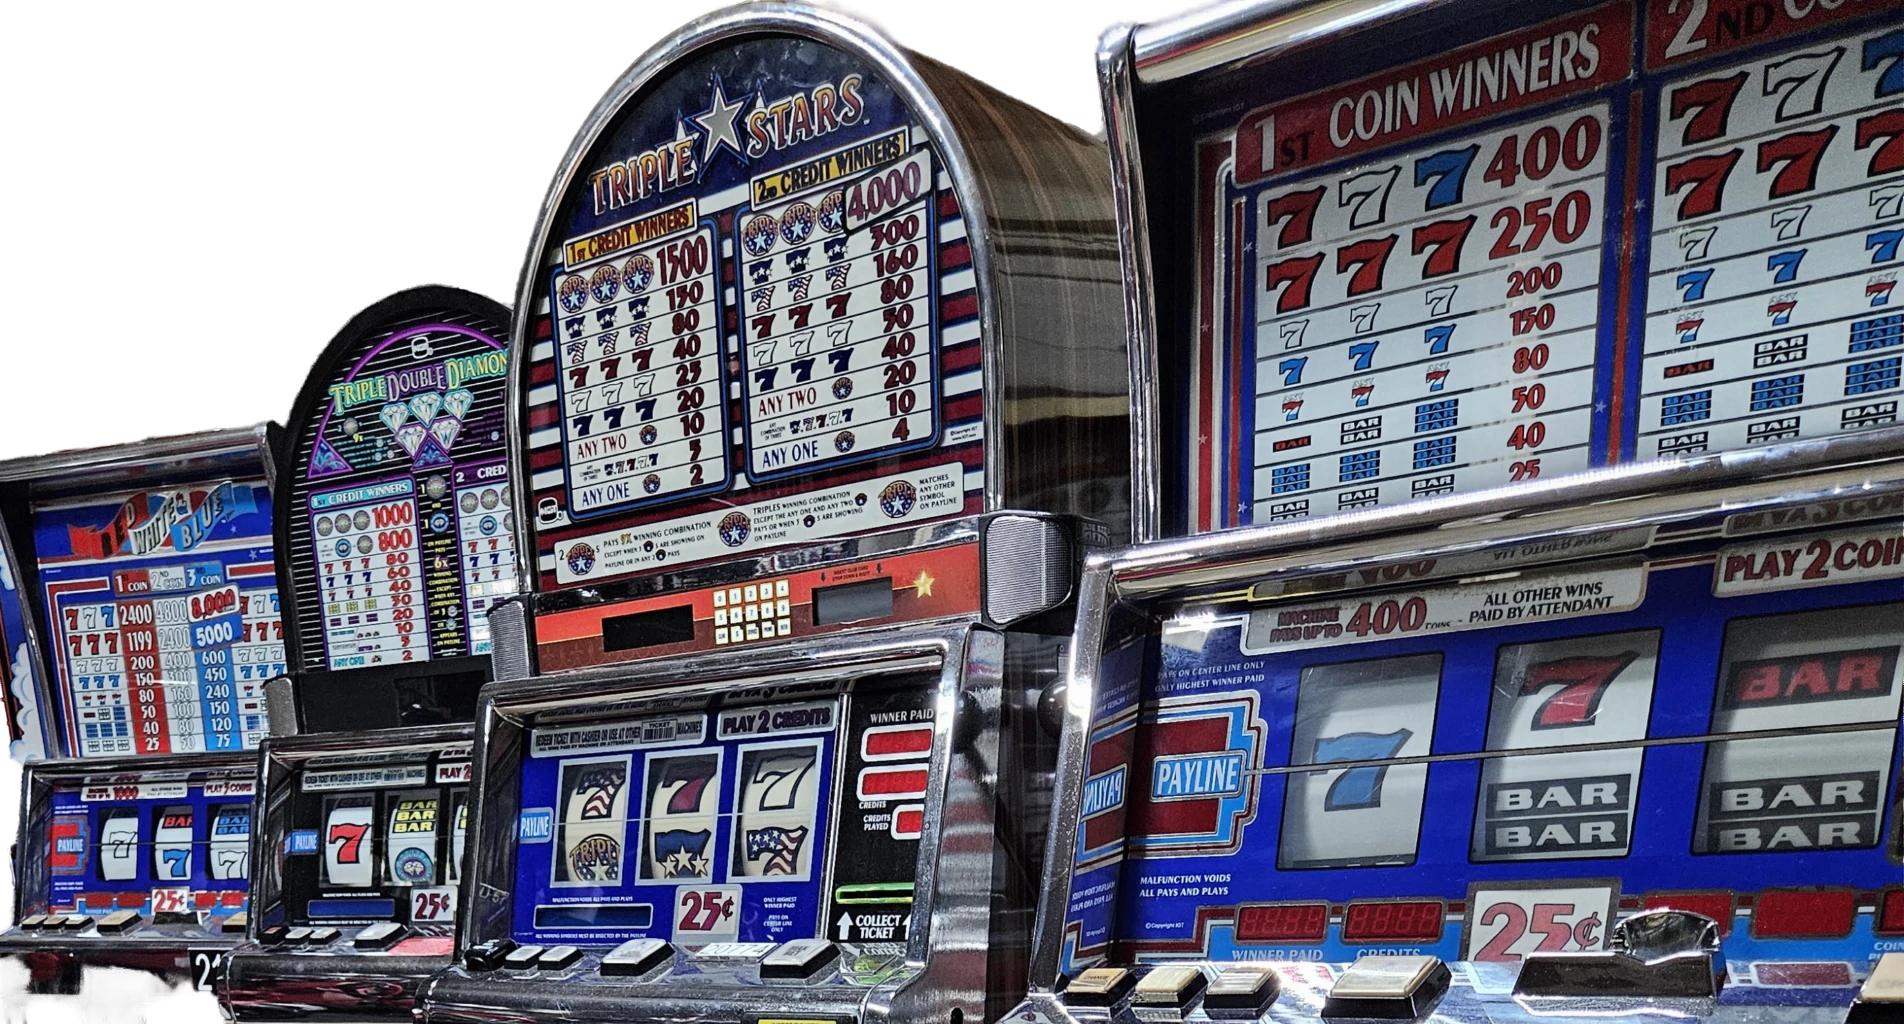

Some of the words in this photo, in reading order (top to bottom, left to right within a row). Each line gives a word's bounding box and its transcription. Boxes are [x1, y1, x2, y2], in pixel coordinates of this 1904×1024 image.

[1254, 113, 1314, 174] 1ST
[1328, 76, 1419, 149] COIN
[1429, 22, 1600, 120] WINNERS
[589, 138, 697, 216] TRIPLE
[747, 73, 863, 159] STARS
[1484, 114, 1602, 189] 400
[780, 159, 834, 195] CREDIT
[837, 134, 902, 177] WINNERS
[848, 161, 921, 221] 4,000
[588, 222, 634, 257] CREDIT
[634, 207, 690, 245] WINNERS
[870, 214, 919, 250] 300
[1489, 190, 1592, 260] 250
[657, 235, 708, 286] 1500
[873, 244, 918, 278] 160
[880, 274, 914, 304] 80
[1507, 262, 1563, 298] 200
[666, 281, 704, 311] 150
[672, 308, 700, 335] 80
[1510, 303, 1555, 337] 150
[1513, 343, 1550, 374] 80
[329, 377, 386, 415] TRIPLE
[386, 365, 446, 402] DOUBLE
[758, 395, 784, 417] ANY
[787, 387, 817, 410] TWO
[887, 389, 916, 416] 10
[1512, 383, 1545, 413] 50
[680, 412, 705, 437] 10
[1507, 422, 1545, 450] 40
[690, 439, 702, 462] 5
[762, 447, 790, 468] ANY
[792, 440, 819, 462] ONE
[690, 465, 703, 486] 2
[919, 474, 949, 484] MATCHES
[934, 481, 955, 490] OTHER
[329, 489, 364, 504] CREDIT
[367, 483, 408, 496] WINNERS
[920, 492, 945, 501] SYMBOL
[931, 497, 957, 508] PAYLINE
[182, 488, 223, 550] BLUE
[372, 501, 413, 529] 1000
[378, 528, 413, 552] 800
[386, 552, 409, 565] 80
[1724, 549, 1802, 582] PLAY
[1802, 539, 1832, 580] 2
[1484, 592, 1510, 607] ALL
[1513, 586, 1563, 604] OTHER
[1565, 581, 1603, 596] WINS
[120, 604, 152, 625] 2400
[1278, 607, 1339, 627] MACHINE
[1346, 596, 1428, 638] 400
[1469, 607, 1503, 624] PAID
[1505, 605, 1526, 620] BY
[1527, 595, 1614, 617] ATTENDANT
[126, 631, 152, 651] 1199
[196, 621, 233, 647] 5000
[1155, 683, 1175, 692] ONLY
[1176, 680, 1210, 690] HIGHEST
[1212, 677, 1242, 686] WINNER
[1244, 674, 1265, 683] PAID
[1179, 669, 1189, 677] ON
[1192, 666, 1222, 675] CENTER
[1224, 663, 1241, 672] LINE
[1243, 661, 1265, 670] ONLY
[1739, 655, 1885, 701] BAR
[722, 717, 756, 735] PLAY
[757, 711, 769, 732] 2
[771, 707, 831, 729] CREDITS
[870, 711, 908, 722] WINNER
[909, 708, 934, 721] PAID
[1158, 759, 1240, 796] PAYLINE
[859, 800, 887, 810] CREDITS
[1495, 781, 1619, 812] BAR
[1720, 779, 1865, 812] BAR
[520, 814, 549, 839] PAYLINE
[863, 814, 891, 823] CREDITS
[863, 822, 889, 832] PLAYED
[1494, 820, 1617, 848] BAR
[1718, 821, 1862, 851] BAR
[1140, 875, 1201, 885] MALFUNCTION
[1204, 874, 1231, 882] VOIDS
[1140, 889, 1154, 897] ALL
[1157, 888, 1178, 897] PAYS
[1180, 888, 1199, 896] AND
[1202, 887, 1228, 895] PLAYS
[154, 890, 185, 912] 25¢
[415, 892, 449, 920] 25¢
[679, 890, 734, 931] 25¢
[855, 914, 902, 927] COLLECT
[860, 927, 895, 939] TICKET
[1232, 949, 1284, 961] WINNER
[1289, 949, 1324, 961] PAID
